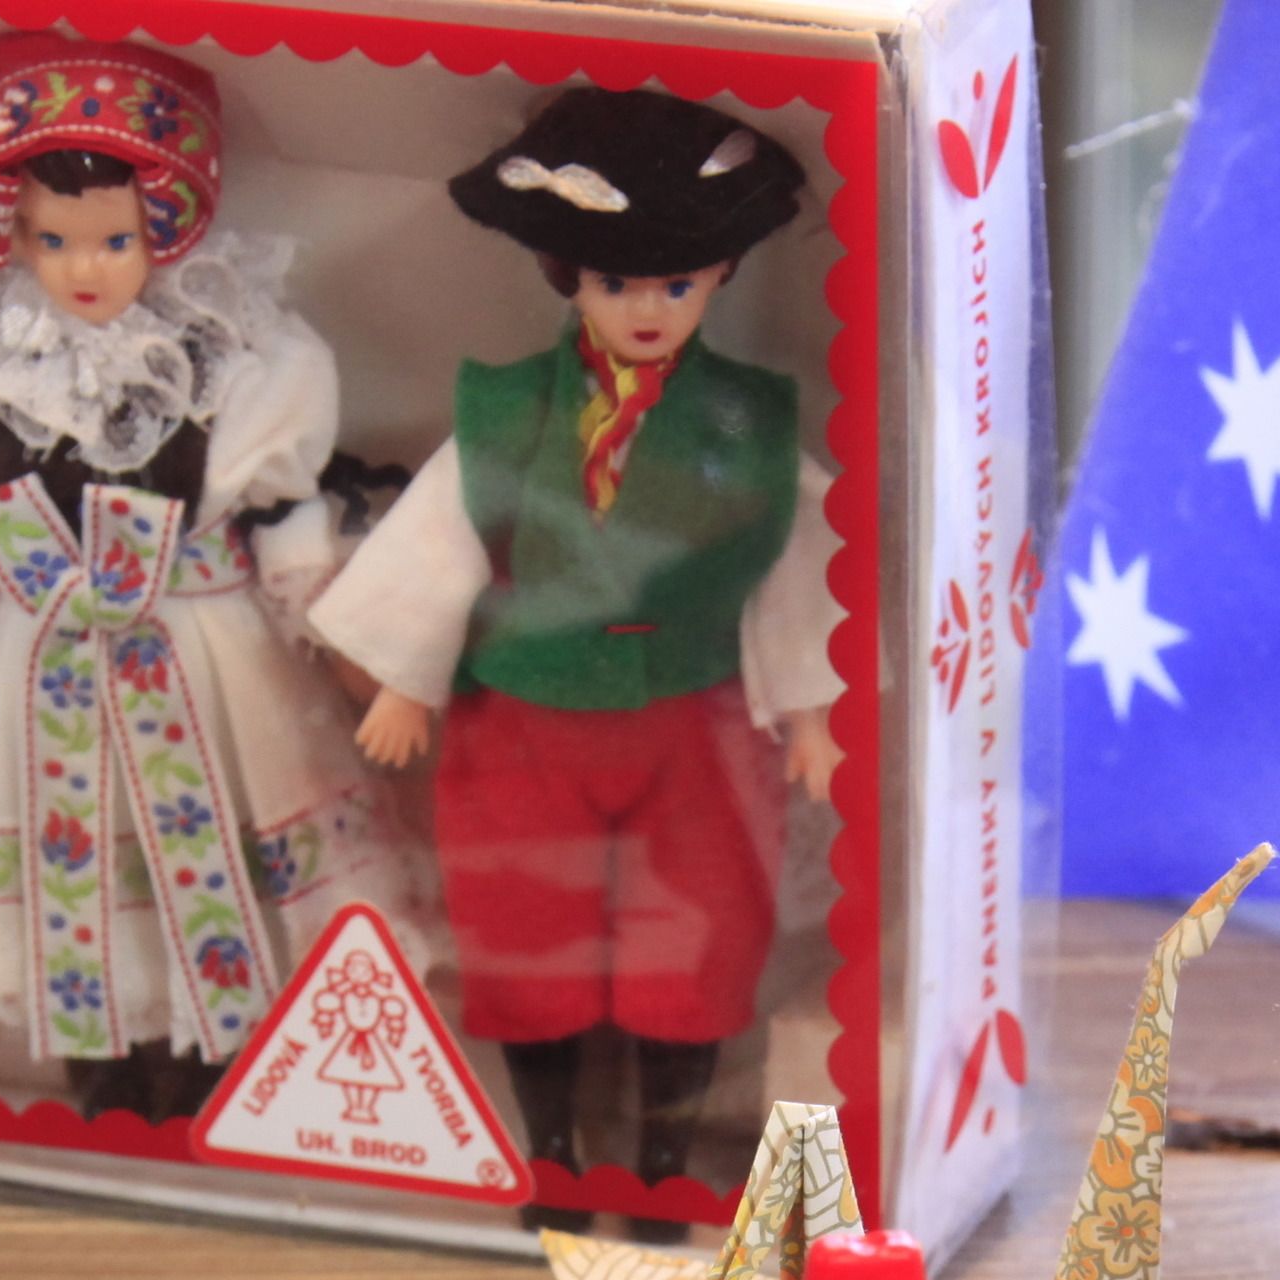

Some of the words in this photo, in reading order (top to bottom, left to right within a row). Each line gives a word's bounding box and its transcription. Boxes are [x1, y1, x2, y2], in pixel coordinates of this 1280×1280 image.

[980, 729, 997, 758] V
[981, 779, 998, 1001] PANENKY
[410, 1045, 474, 1149] TVORBA
[296, 1127, 342, 1157] UH.
[350, 1135, 428, 1167] BROD
